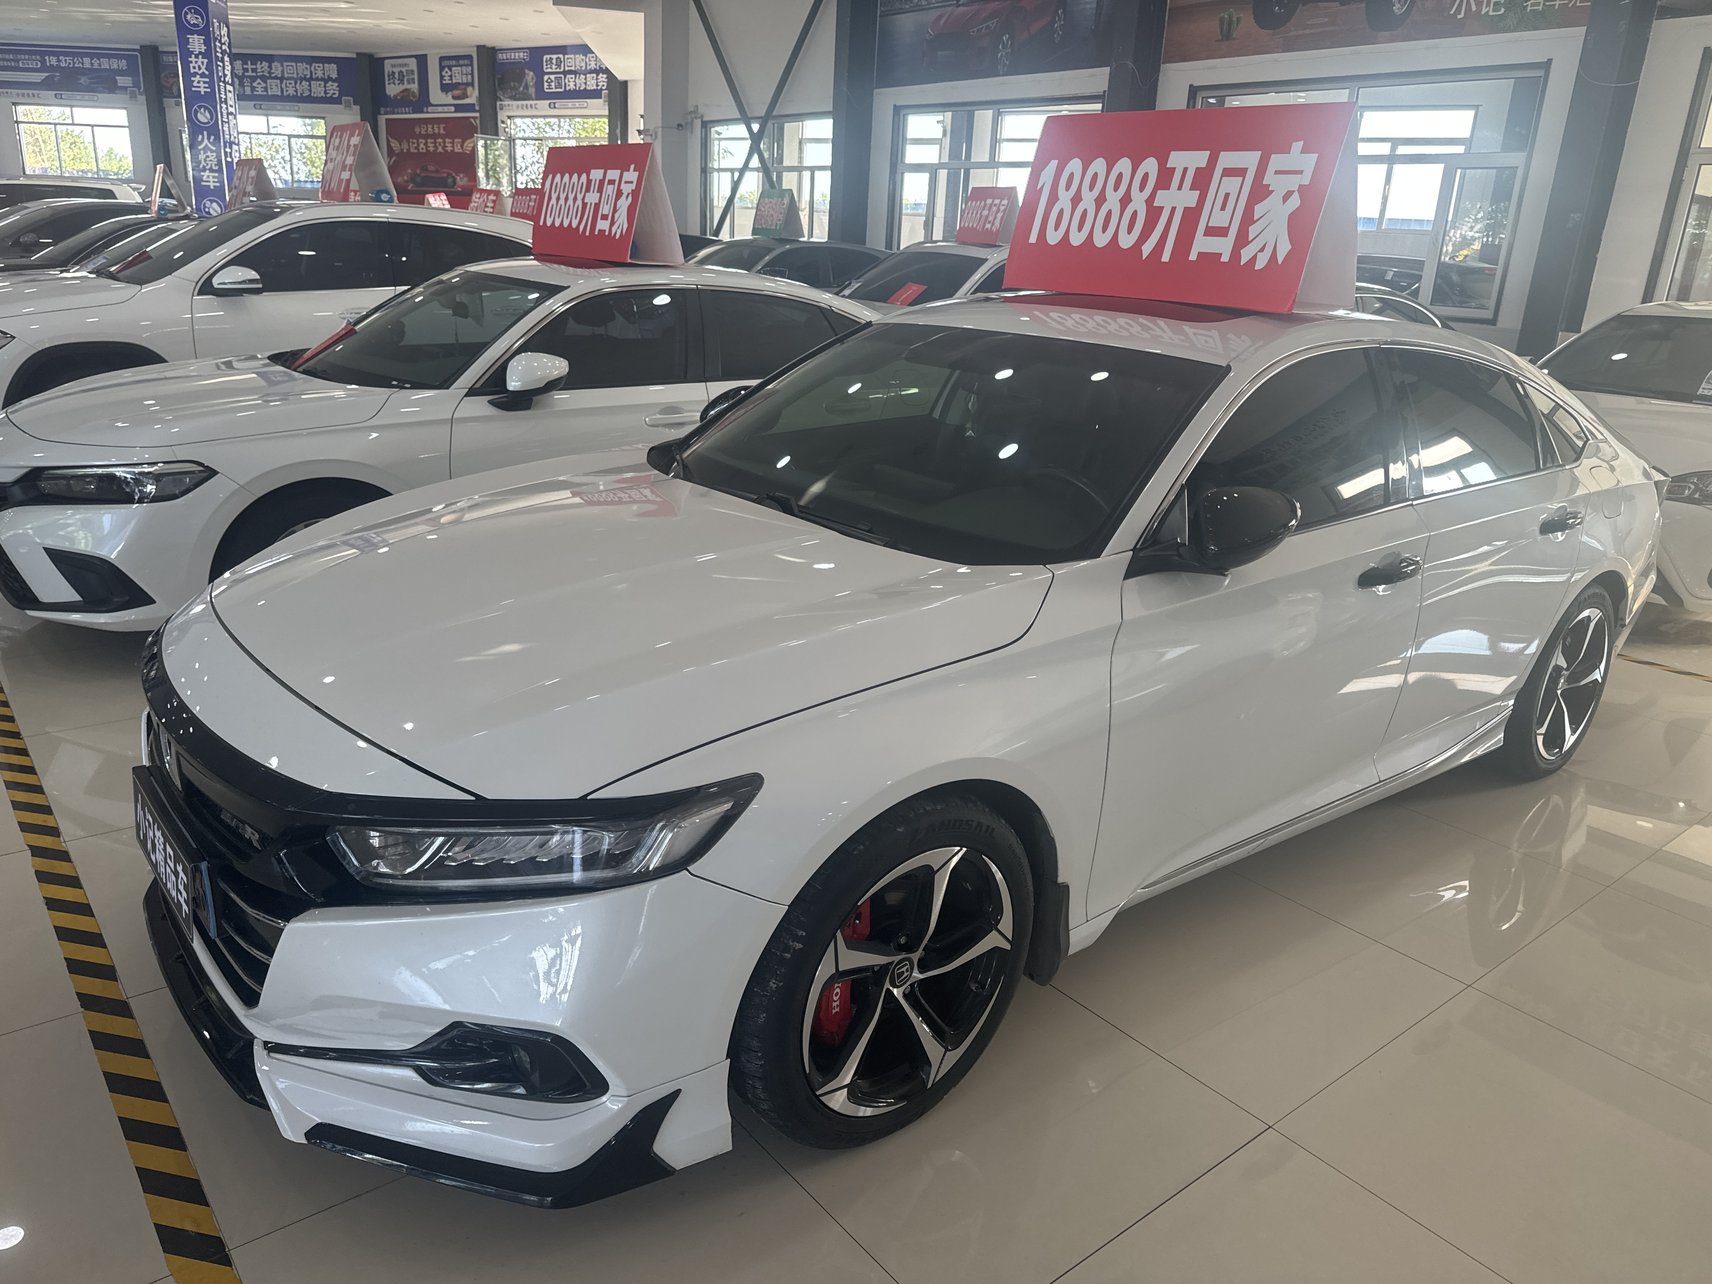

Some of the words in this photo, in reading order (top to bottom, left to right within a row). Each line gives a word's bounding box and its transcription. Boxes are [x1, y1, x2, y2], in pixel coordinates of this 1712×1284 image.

[44, 55, 128, 70] 1年3万公里全国保修
[186, 34, 211, 95] 事故车
[387, 69, 405, 86] 终身
[442, 66, 461, 84] 全国
[544, 73, 608, 91] 全国保修服务
[401, 138, 464, 153] 小记名车交车区
[197, 131, 221, 190] 火烧车
[468, 191, 497, 214] 特价车
[539, 163, 640, 239] 18888开回家
[1028, 140, 1318, 270] 18888开回家
[137, 793, 189, 919] 小记精品车
